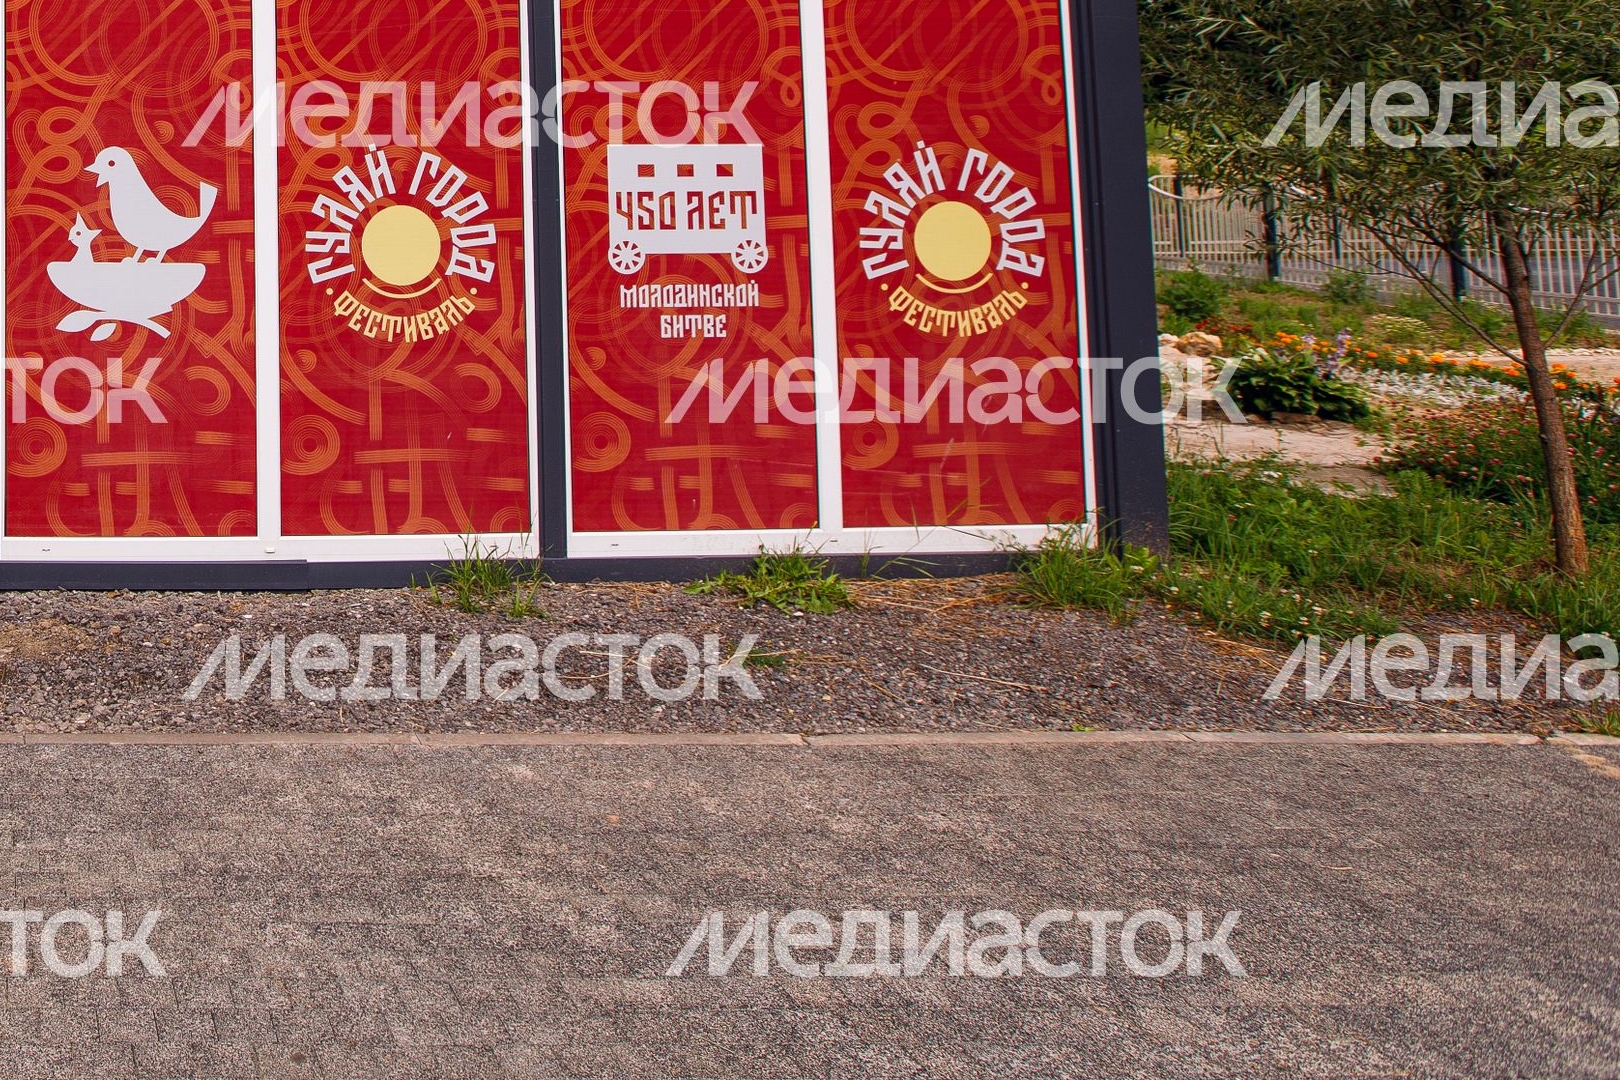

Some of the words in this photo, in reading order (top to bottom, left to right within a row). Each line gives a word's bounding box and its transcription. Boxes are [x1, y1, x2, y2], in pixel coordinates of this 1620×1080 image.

[615, 191, 675, 230] 450
[686, 191, 757, 230] ЛЕТ
[620, 280, 759, 308] МОЛОДИНСКОЙ
[888, 286, 1029, 337] ФЕСТИВАЛЬ
[334, 289, 476, 343] ФЕСТИВАЛЬ
[660, 314, 727, 338] БИТВЕ
